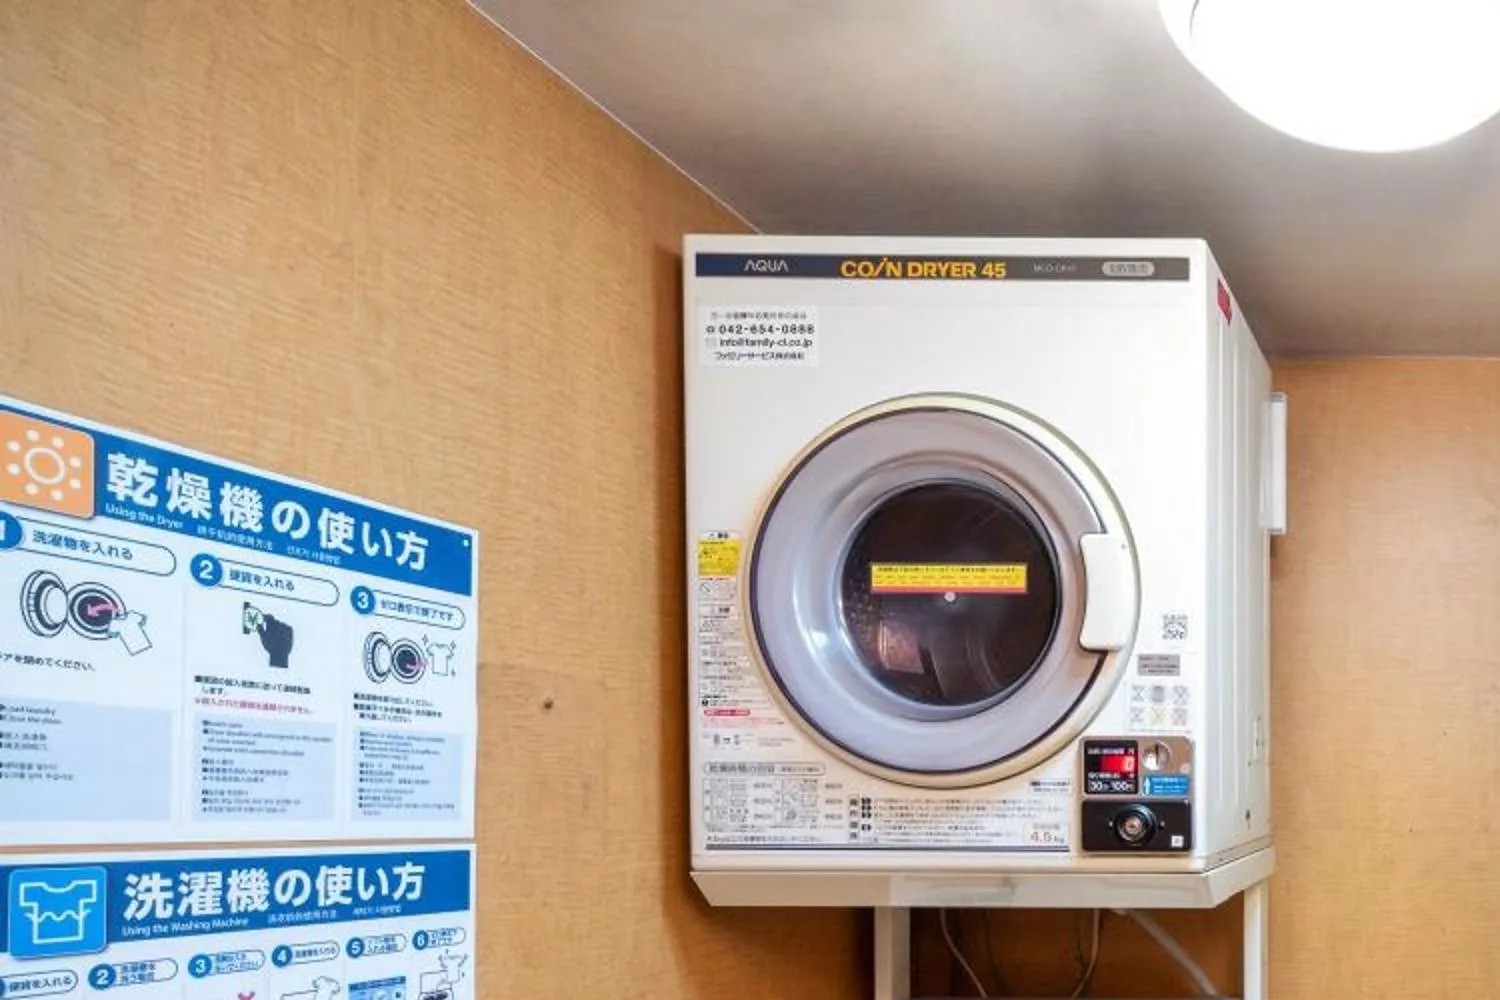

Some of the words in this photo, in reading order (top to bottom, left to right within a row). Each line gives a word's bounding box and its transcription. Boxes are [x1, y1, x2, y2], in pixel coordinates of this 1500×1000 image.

[744, 260, 789, 272] AQUA
[906, 261, 977, 277] DRYER
[982, 262, 1007, 277] 45
[105, 503, 136, 522] Using
[138, 510, 155, 522] the
[156, 514, 184, 530] Dryer
[106, 452, 429, 571] 乾燥機の使い方
[199, 559, 214, 580] 2
[357, 591, 369, 609] 3
[123, 861, 425, 921] 洗濯機の使い方
[122, 925, 150, 937] Using
[152, 924, 169, 934] the
[171, 920, 211, 934] Washing
[212, 917, 249, 929] Machine
[351, 940, 360, 954] 5
[417, 934, 425, 946] 6
[277, 950, 287, 962] 4
[195, 959, 205, 973] 3
[96, 970, 109, 985] 2
